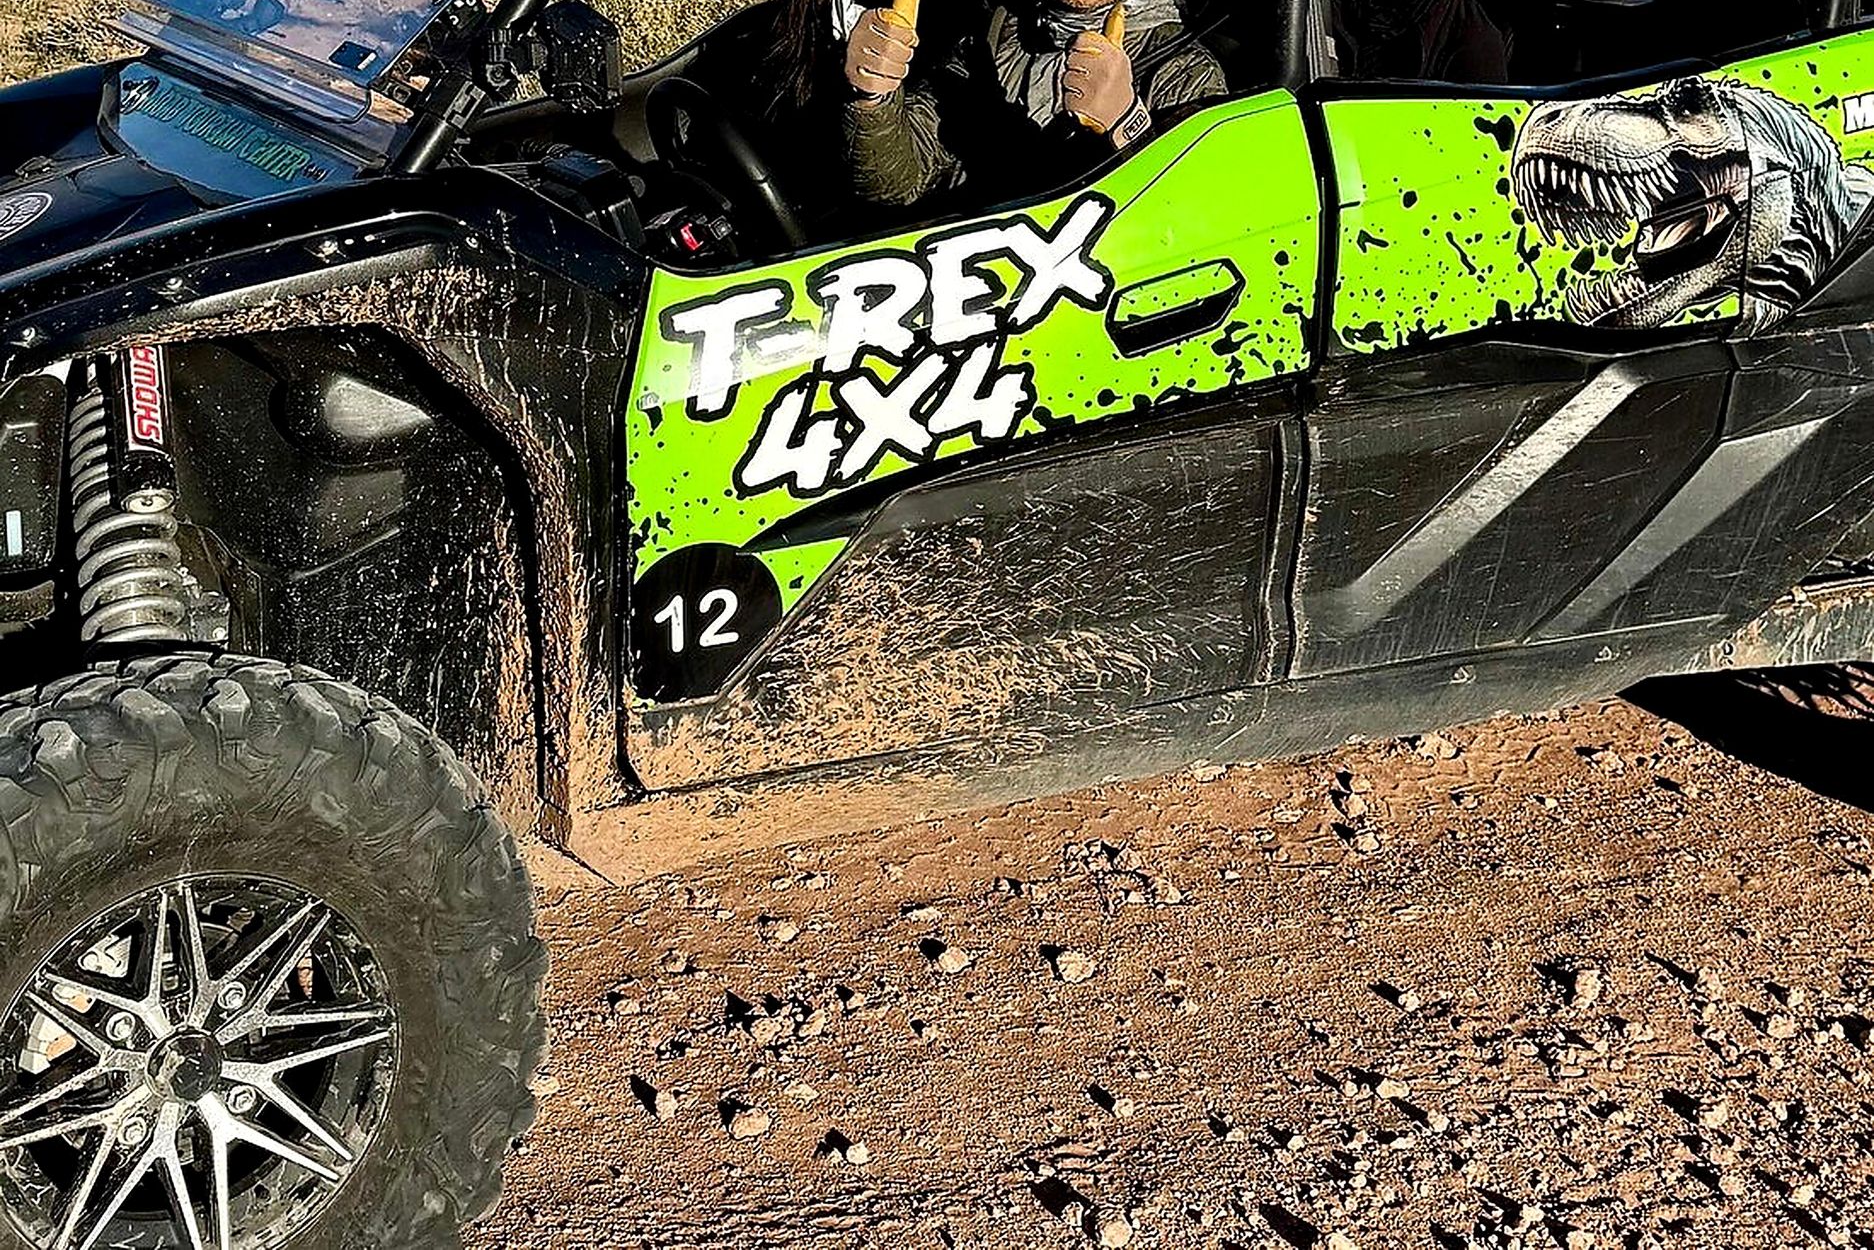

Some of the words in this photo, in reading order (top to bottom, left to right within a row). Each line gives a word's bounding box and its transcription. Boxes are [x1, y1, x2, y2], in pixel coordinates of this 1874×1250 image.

[664, 193, 1113, 418] T-REX
[131, 343, 162, 443] SHOWA
[654, 588, 740, 653] 12
